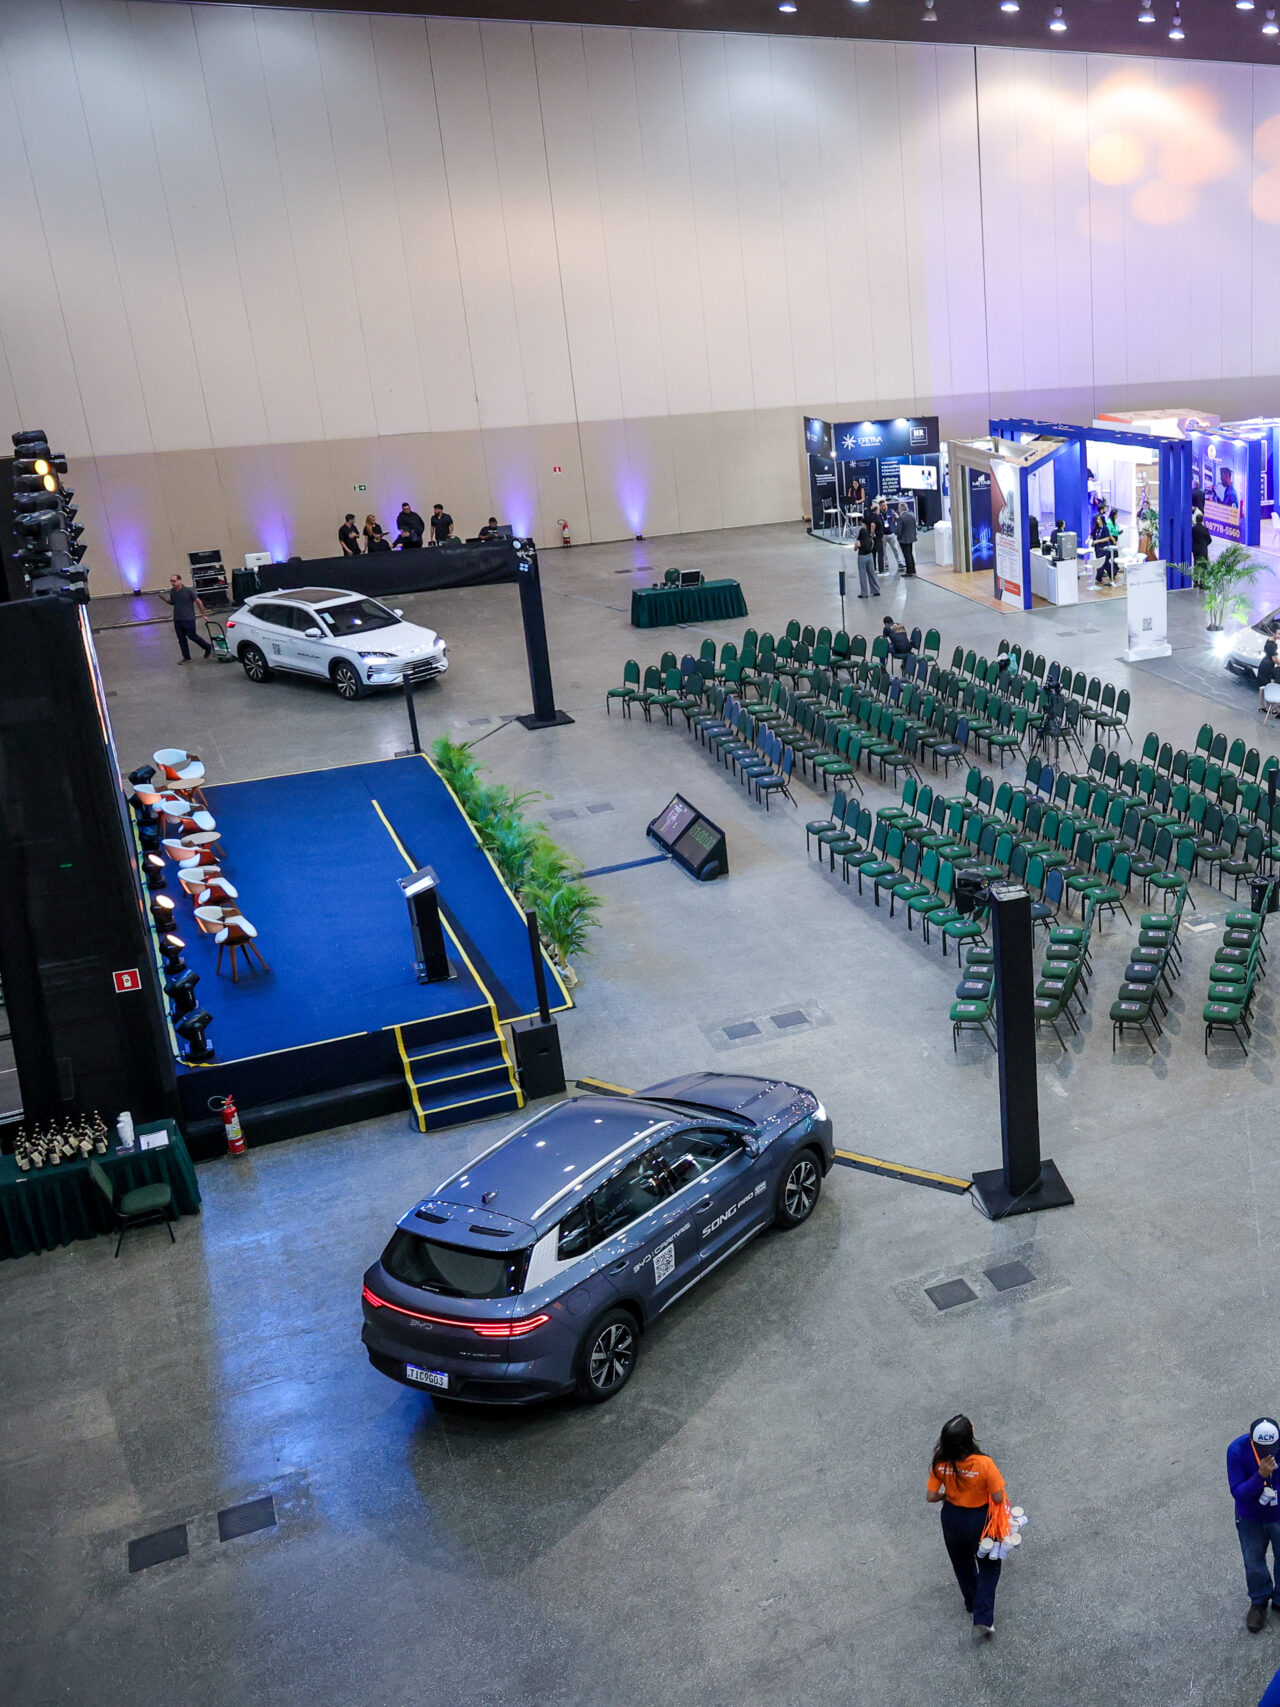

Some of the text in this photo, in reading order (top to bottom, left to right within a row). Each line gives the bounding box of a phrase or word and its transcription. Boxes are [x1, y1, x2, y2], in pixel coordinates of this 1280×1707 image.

[702, 1192, 754, 1239] SONG PRO
[633, 1254, 652, 1274] BYD
[1258, 1433, 1275, 1441] ACN
